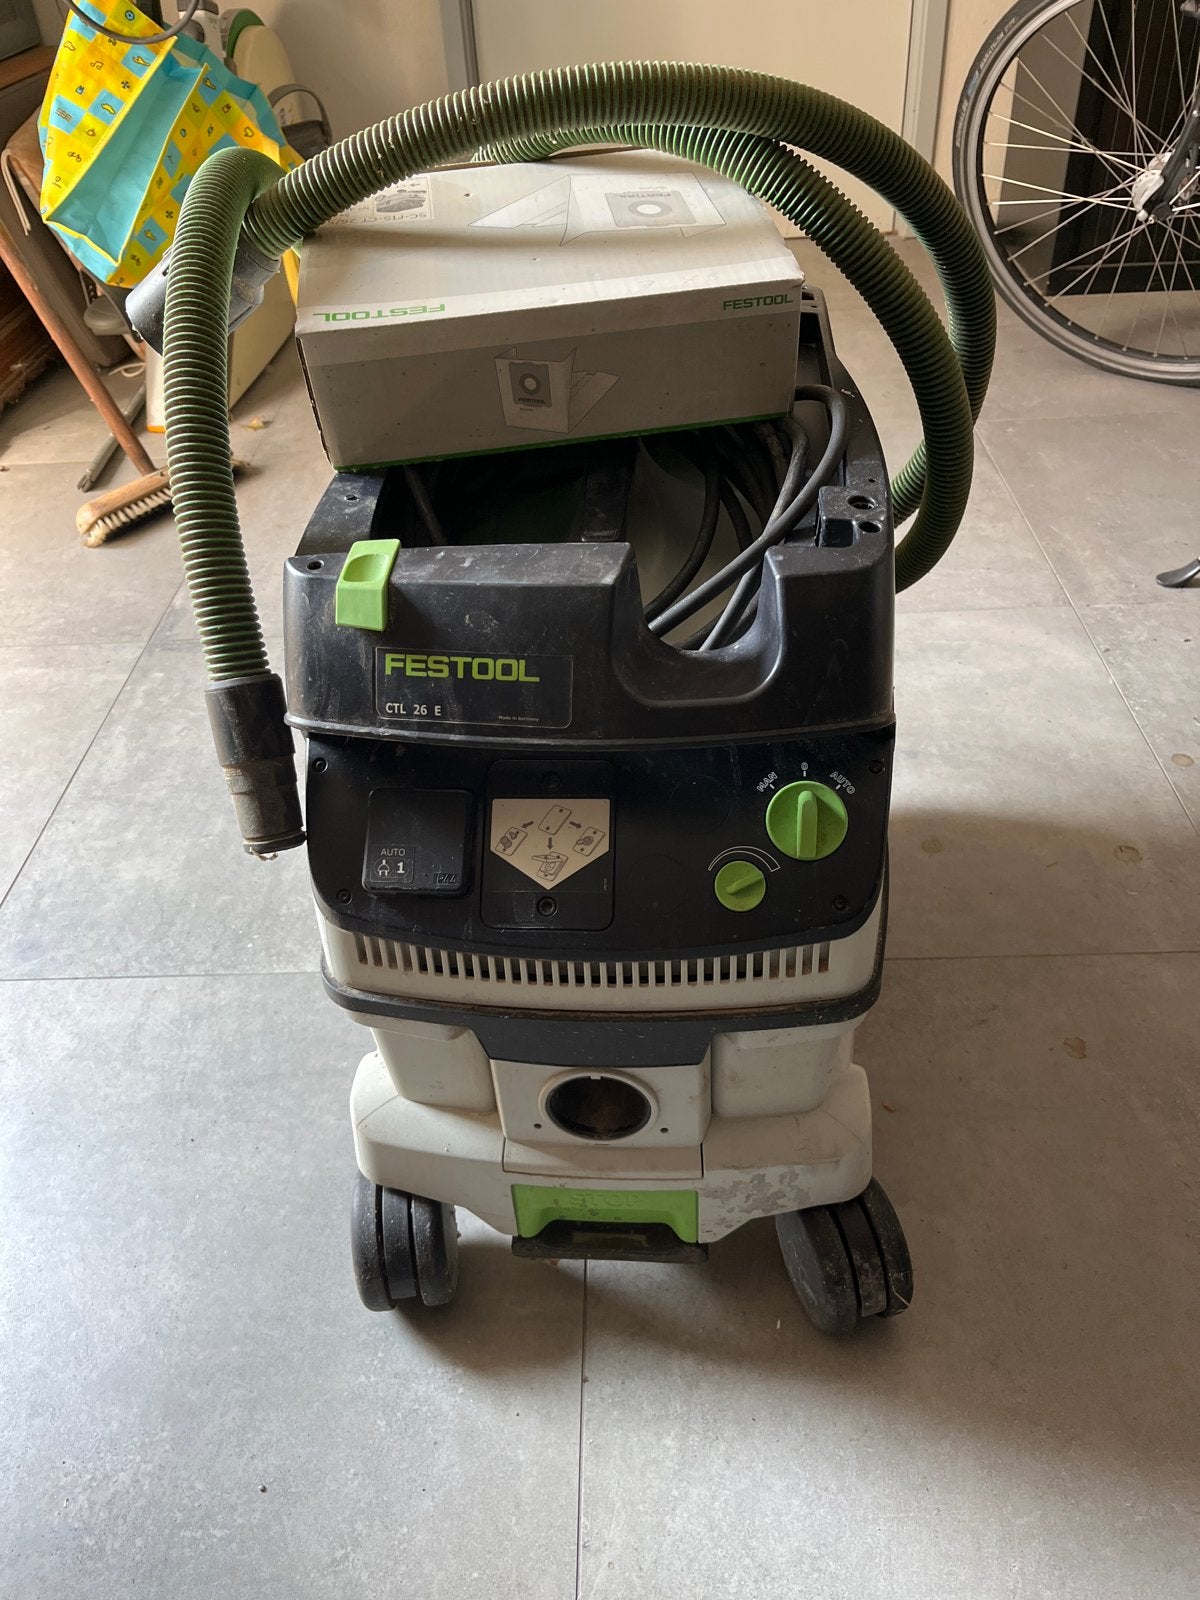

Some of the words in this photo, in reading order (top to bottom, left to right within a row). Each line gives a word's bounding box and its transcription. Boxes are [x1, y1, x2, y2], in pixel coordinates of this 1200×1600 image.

[723, 294, 794, 311] FESTOOL
[313, 303, 446, 322] FESTOOL
[384, 653, 540, 682] FESTOOL
[385, 702, 407, 714] CTL
[413, 704, 428, 715] 26
[434, 705, 442, 717] E
[756, 771, 778, 793] MAN
[829, 771, 856, 795] AUTO
[380, 848, 406, 856] AUTO
[396, 861, 405, 874] 1
